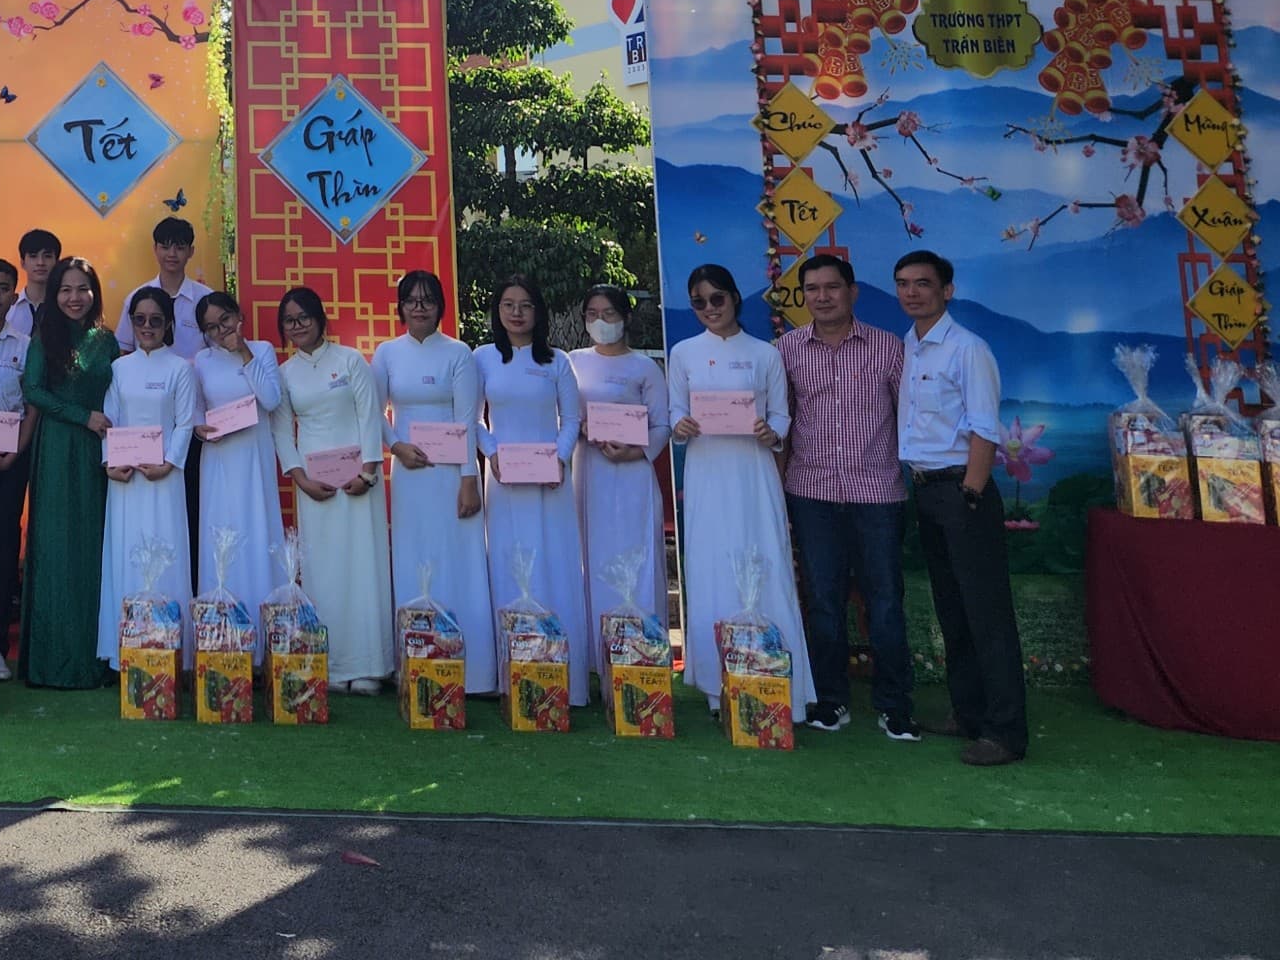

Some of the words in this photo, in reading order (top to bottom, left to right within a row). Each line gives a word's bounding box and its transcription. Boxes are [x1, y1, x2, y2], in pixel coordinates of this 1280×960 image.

[929, 10, 985, 29] TRƯỜNG
[988, 14, 1022, 30] THPT
[943, 33, 982, 55] TRẤN
[984, 37, 1016, 55] BIÊN
[766, 111, 823, 132] Chúc
[62, 117, 138, 165] Tết
[302, 109, 377, 167] Giáp
[306, 169, 382, 209] Thìn
[780, 199, 819, 225] Tết
[1190, 206, 1245, 227] Xuân
[781, 286, 806, 308] 20
[1208, 279, 1245, 305] Giáp
